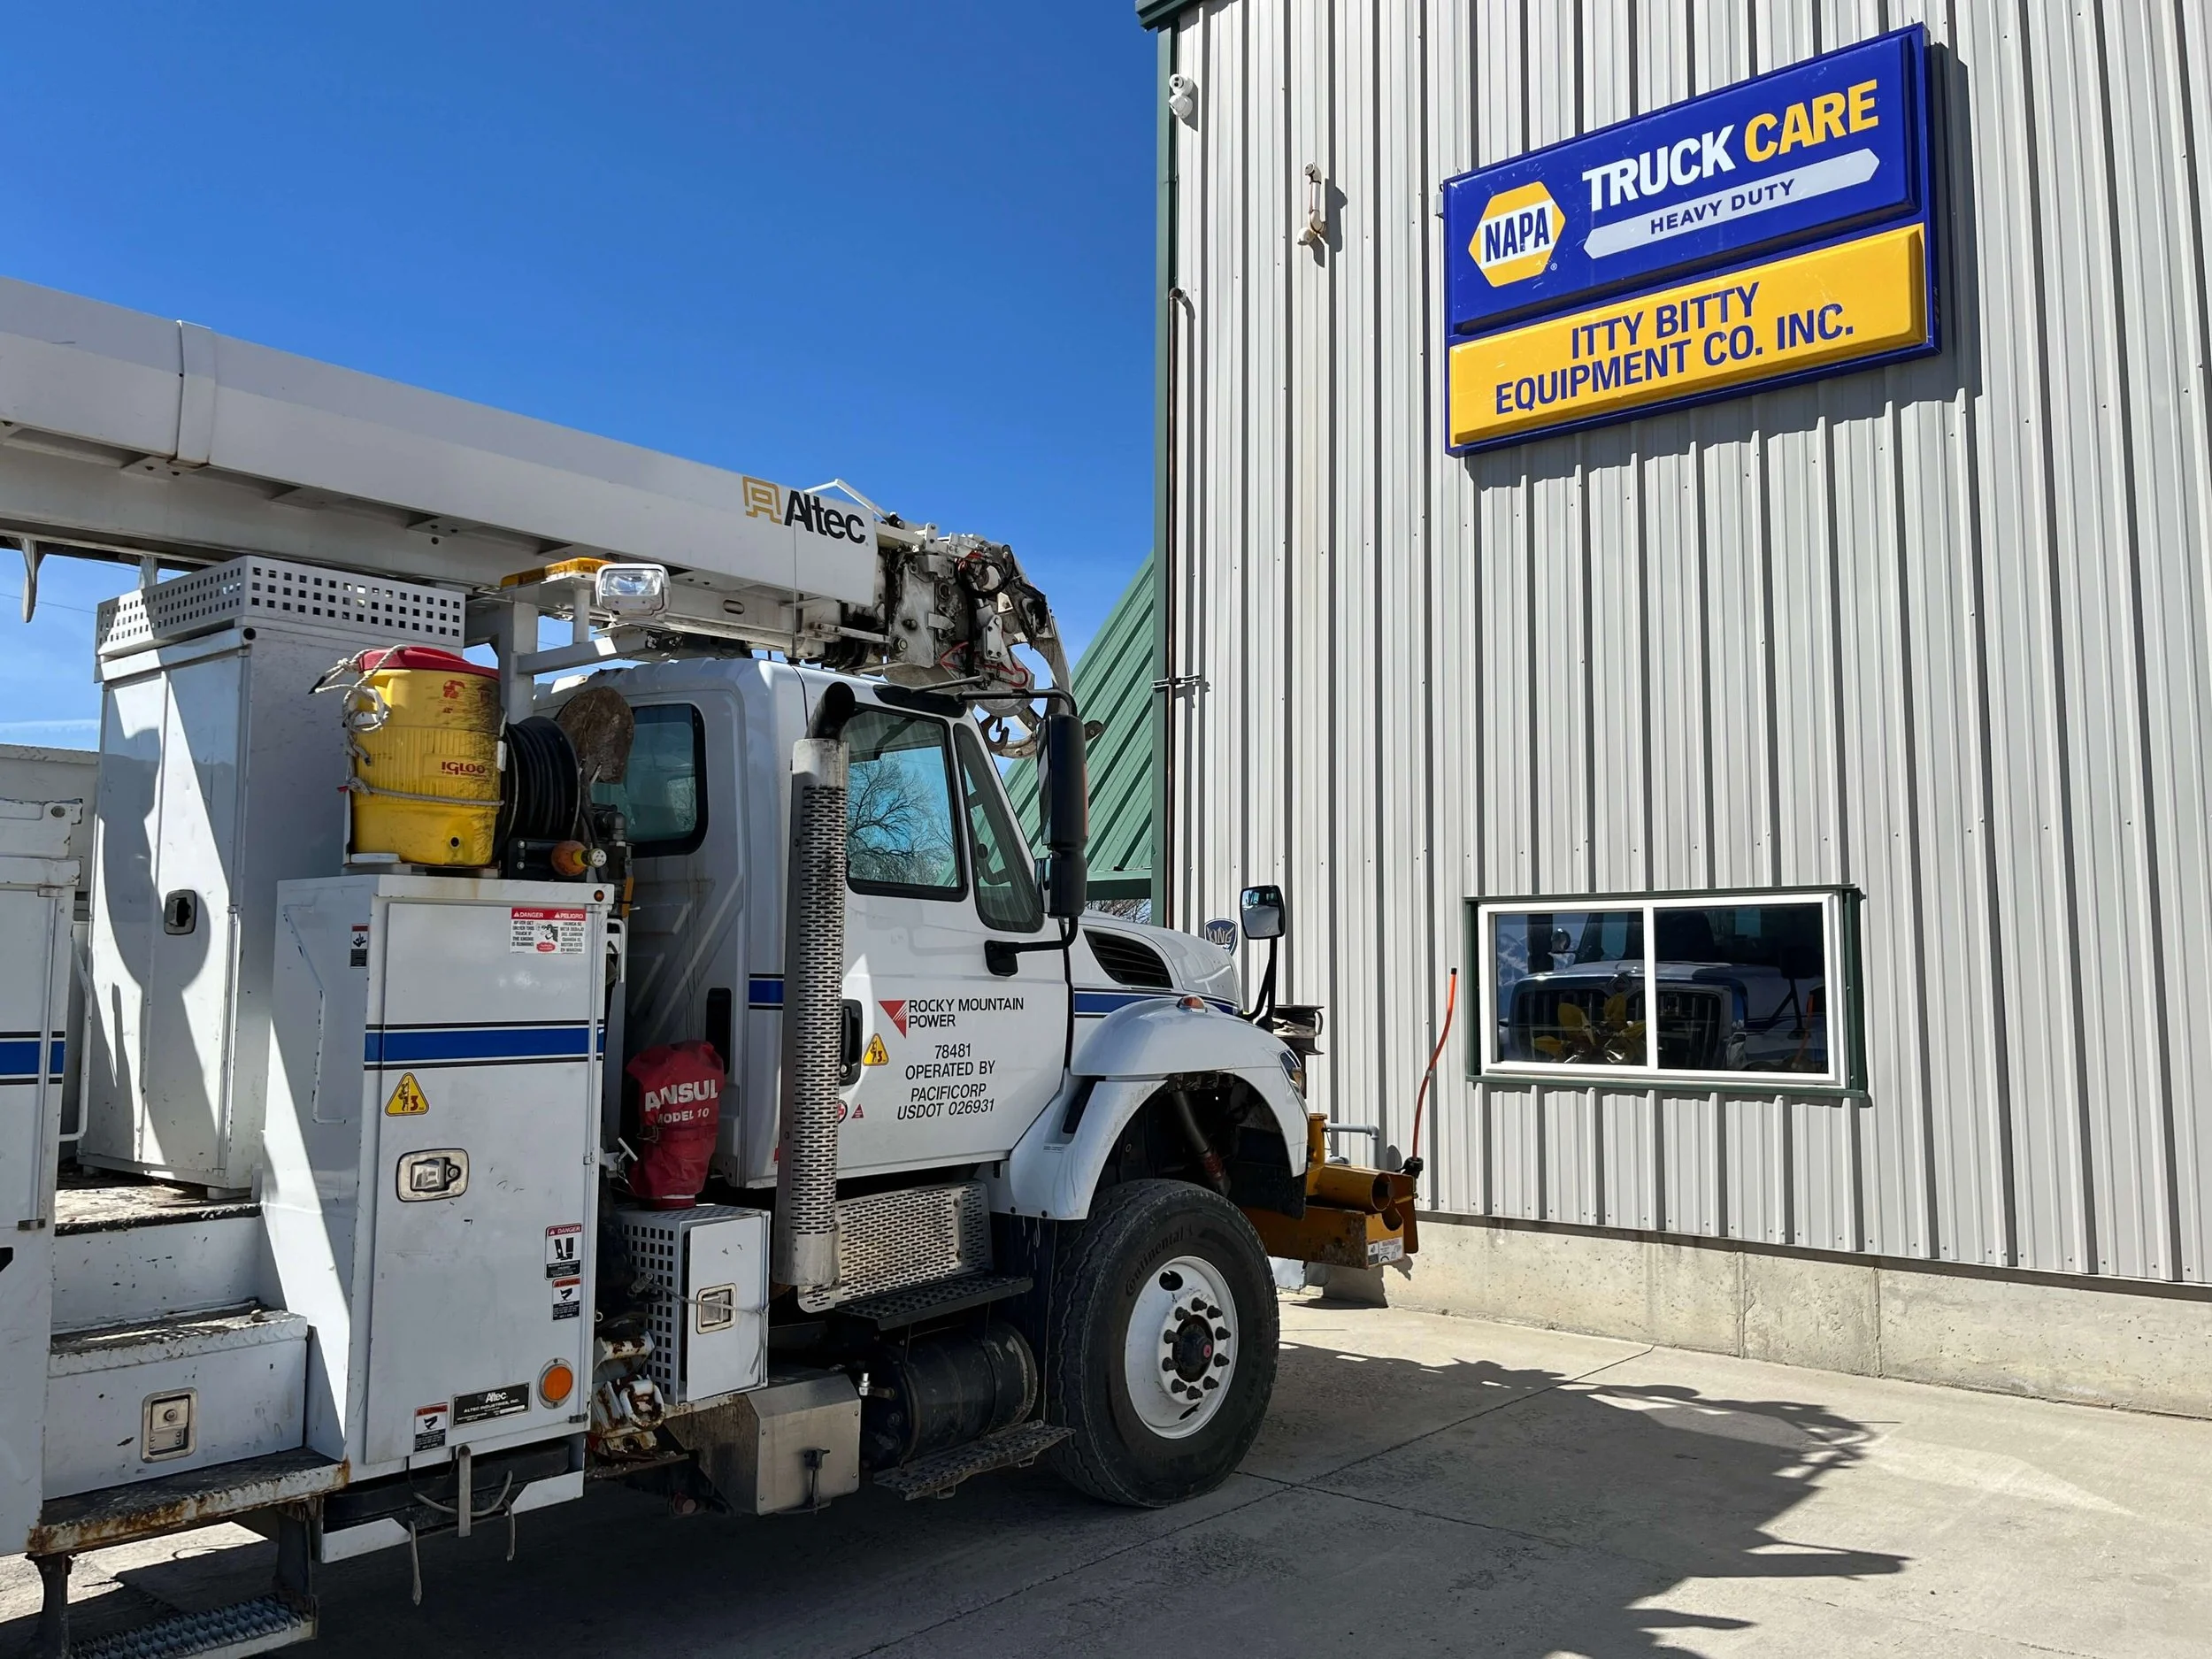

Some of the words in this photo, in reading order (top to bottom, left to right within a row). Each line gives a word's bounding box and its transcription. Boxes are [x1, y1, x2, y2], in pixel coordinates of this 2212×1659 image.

[1582, 125, 1736, 211] TRUCK
[1744, 79, 1878, 163] CARE
[1650, 199, 1725, 234] HEAVY
[1730, 178, 1795, 212] DUTY
[1485, 206, 1550, 263] NAPA
[1571, 311, 1642, 359] ITTY
[1656, 281, 1759, 340] BITTY
[1495, 339, 1691, 414] EQUIPMENT
[1703, 325, 1763, 367] CO.
[1777, 303, 1854, 350] INC.
[784, 490, 865, 544] Altec
[442, 762, 485, 775] IGLOO
[909, 999, 955, 1013] ROCKY
[958, 997, 1024, 1011] MOUNTAIN
[909, 1014, 956, 1028] POWER
[934, 1043, 971, 1059] 78481
[905, 1062, 973, 1080] OPERATED
[979, 1060, 995, 1075] BY
[645, 1079, 718, 1111] ANSUL
[910, 1083, 987, 1102] PACIFICORP
[697, 1108, 710, 1118] 10
[897, 1103, 942, 1120] USDOT
[949, 1099, 995, 1116] 026931
[557, 1225, 580, 1234] DANGER
[1125, 1225, 1184, 1296] Continental
[486, 1392, 507, 1403] Altec
